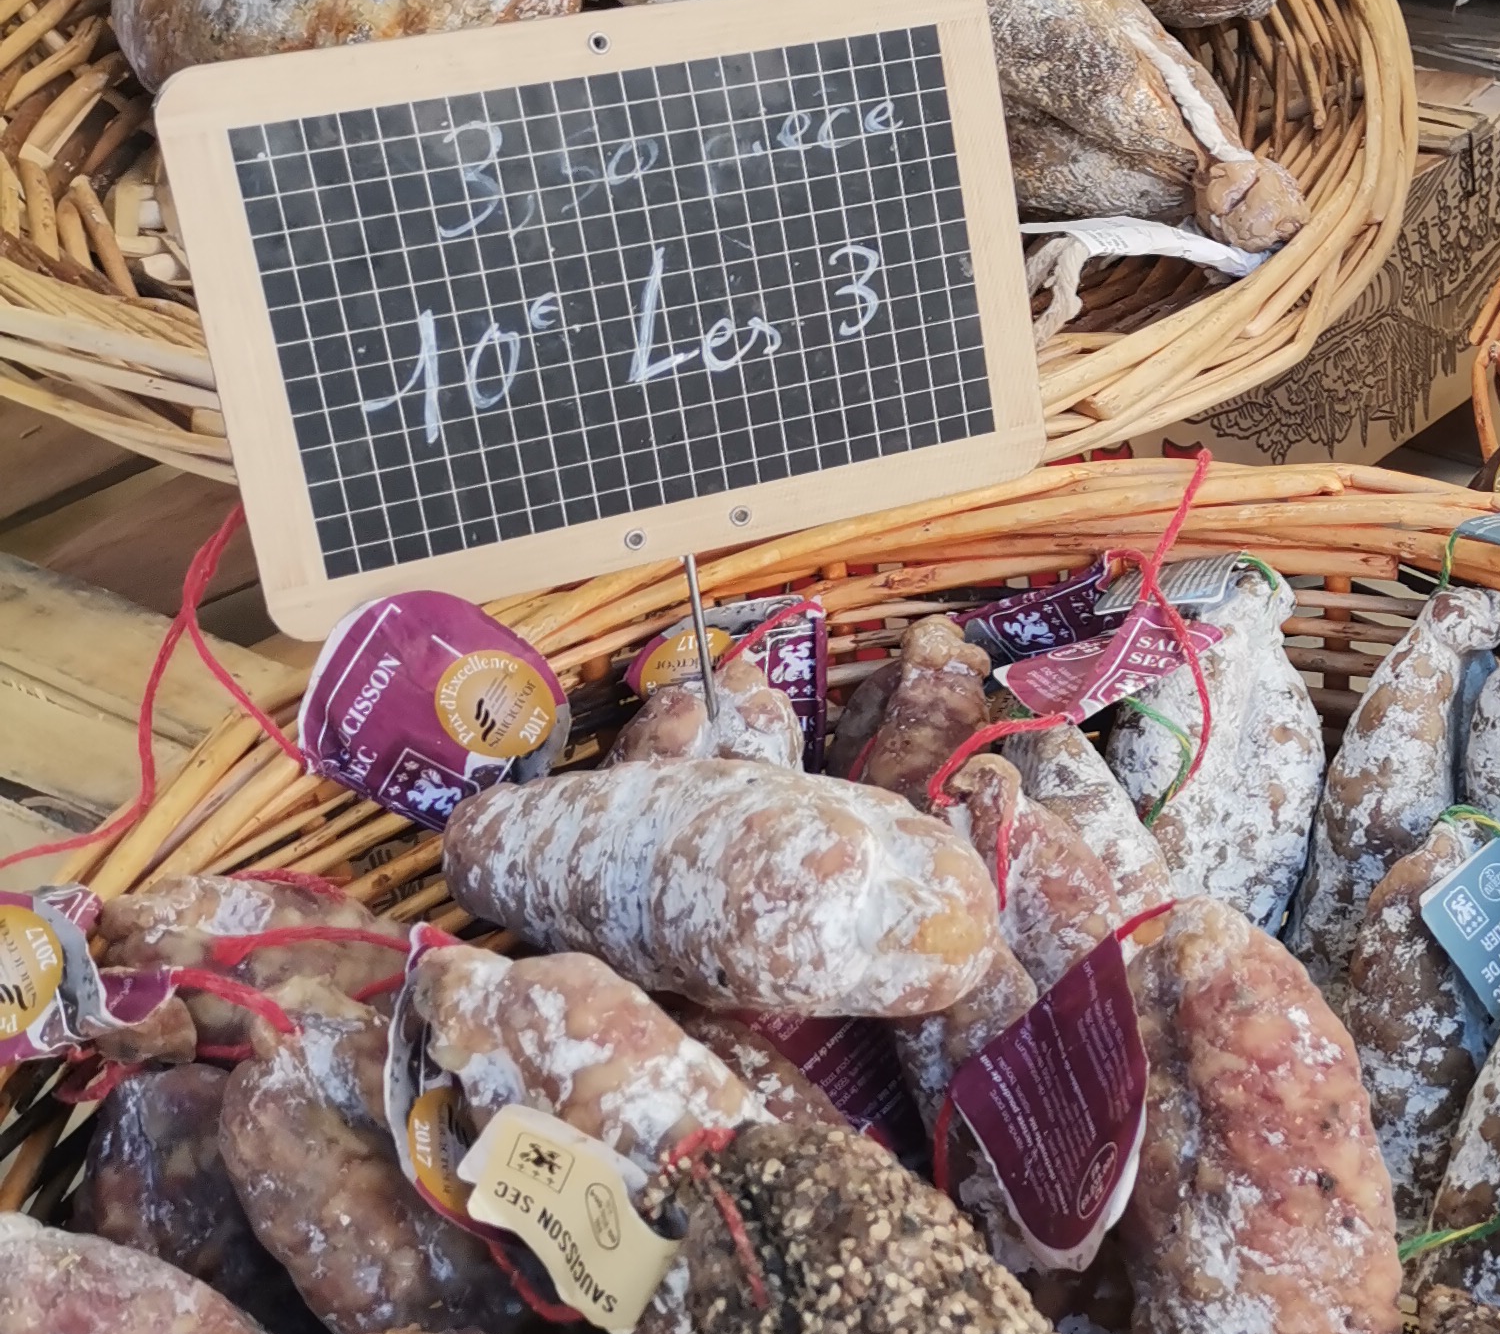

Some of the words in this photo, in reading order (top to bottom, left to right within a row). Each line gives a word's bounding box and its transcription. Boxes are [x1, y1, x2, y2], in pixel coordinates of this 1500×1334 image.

[629, 245, 784, 384] Les
[826, 242, 882, 339] 3
[518, 706, 551, 745] 2017
[24, 927, 58, 972] 2017
[412, 1117, 434, 1169] 2017
[492, 1179, 536, 1215] SEC
[536, 1206, 619, 1315] SAUCISSON
